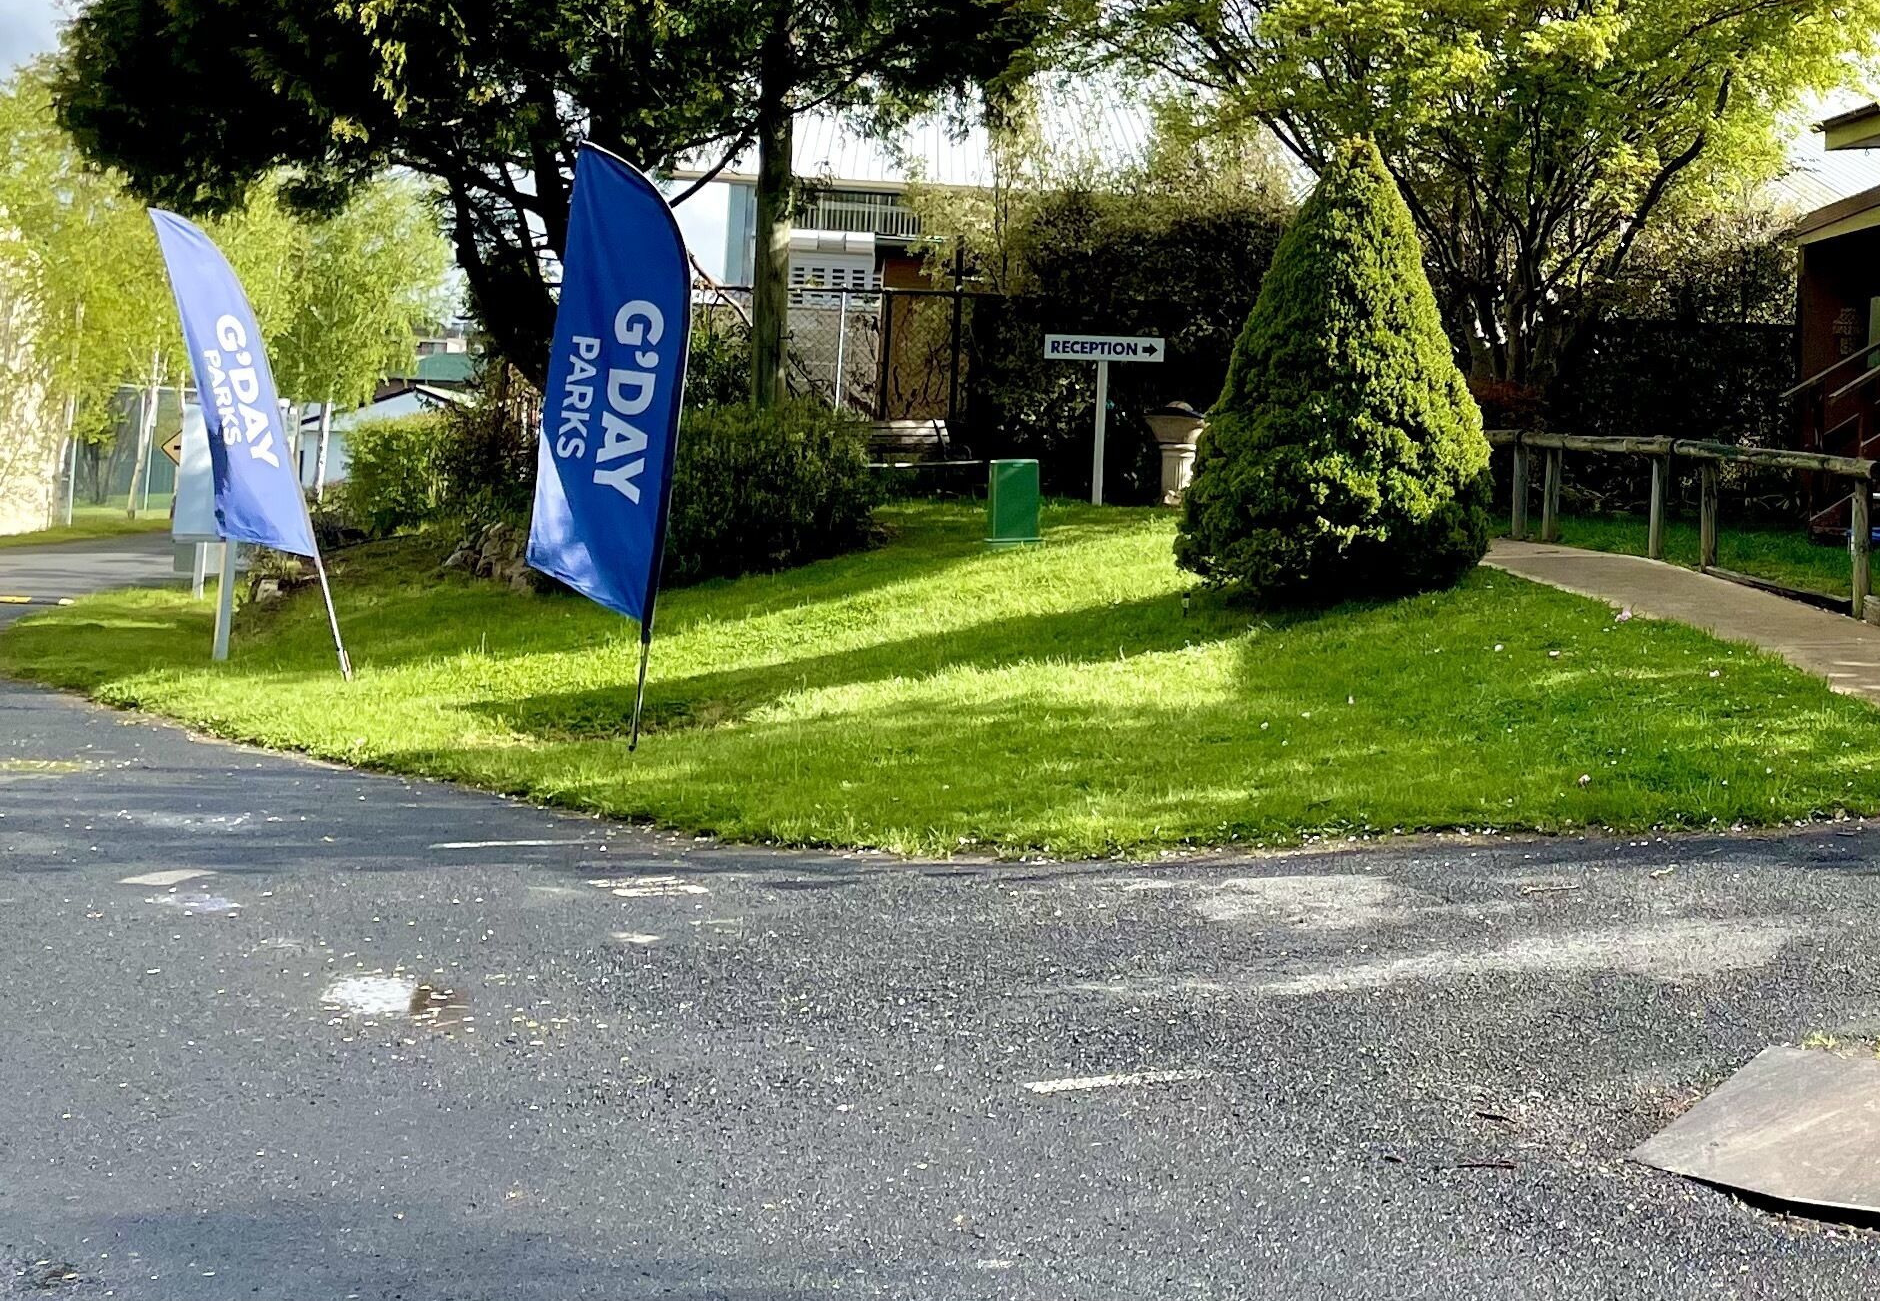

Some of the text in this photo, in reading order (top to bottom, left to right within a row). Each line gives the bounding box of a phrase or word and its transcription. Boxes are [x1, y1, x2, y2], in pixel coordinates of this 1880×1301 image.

[203, 350, 242, 446] PARKS
[216, 314, 280, 468] G'DAY
[556, 335, 601, 460] PARKS
[592, 299, 664, 505] G'DAY
[1050, 340, 1138, 355] RECEPTION
